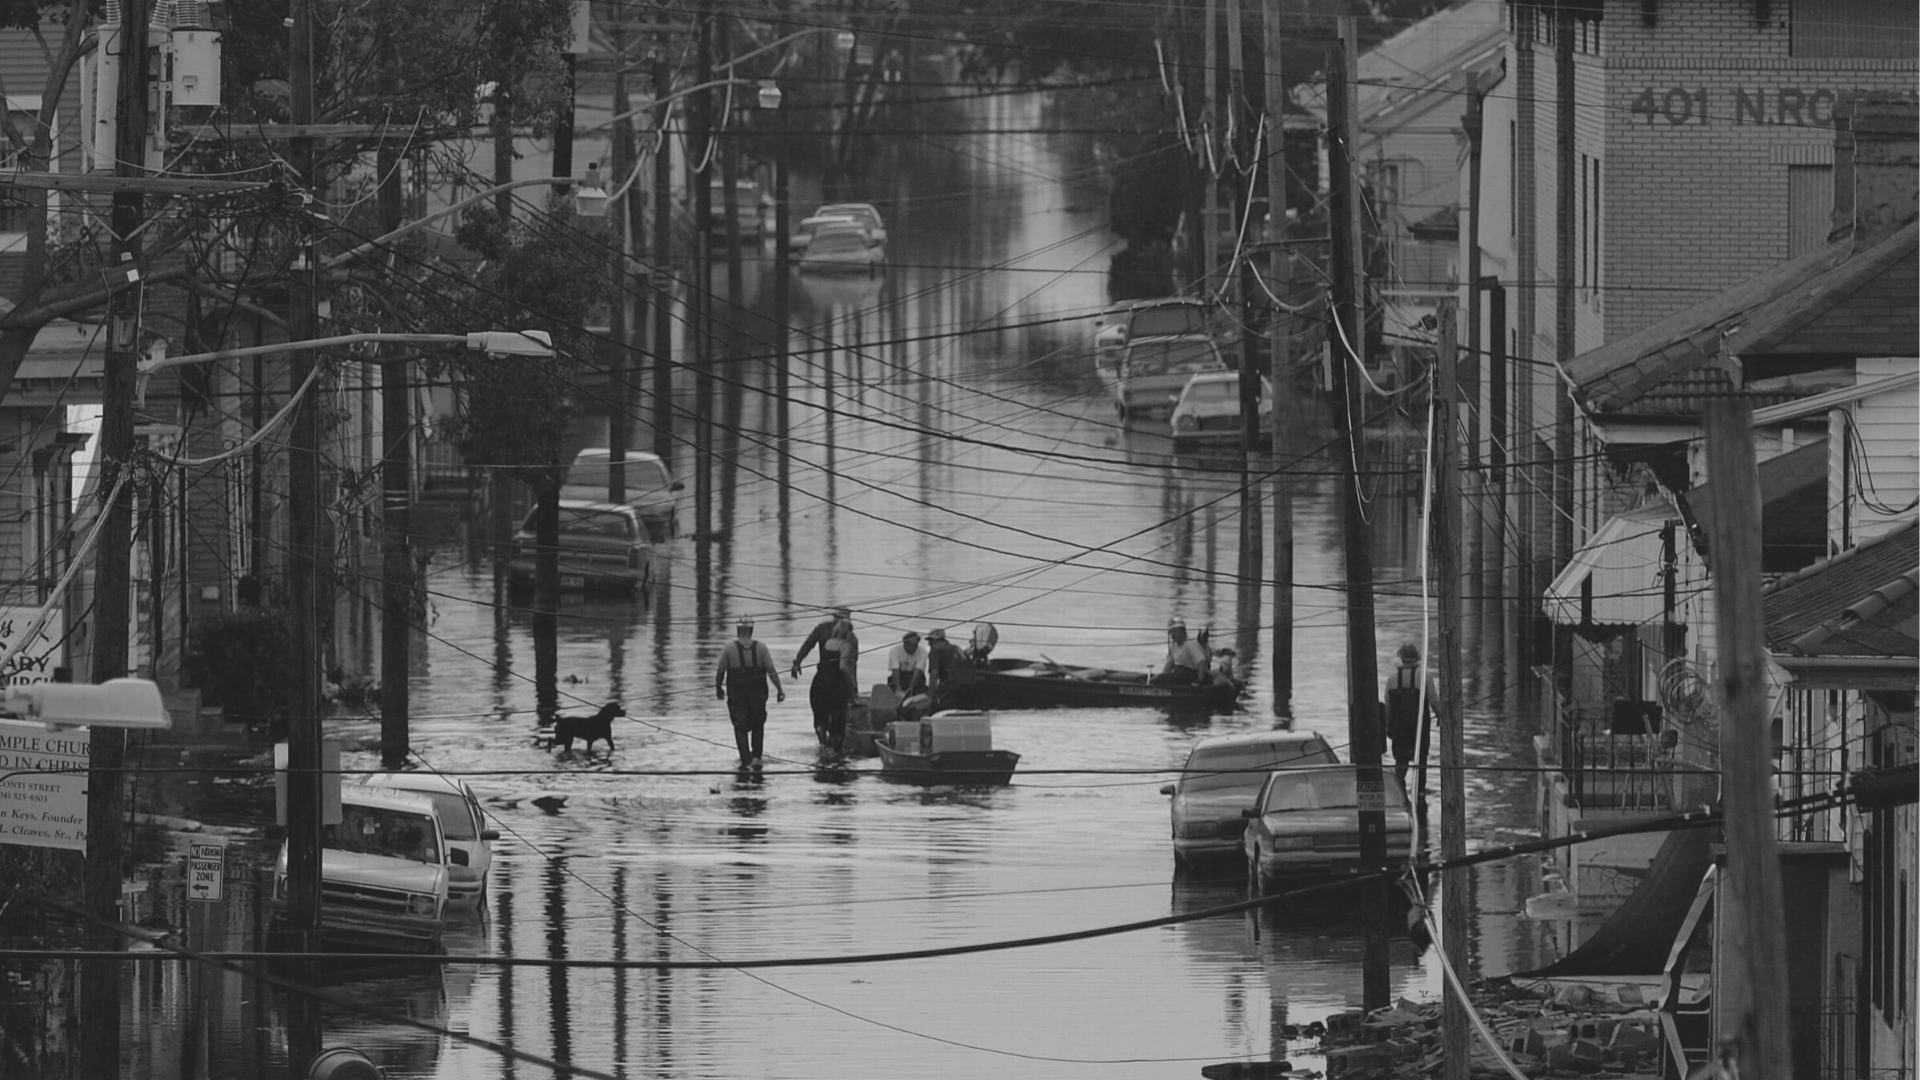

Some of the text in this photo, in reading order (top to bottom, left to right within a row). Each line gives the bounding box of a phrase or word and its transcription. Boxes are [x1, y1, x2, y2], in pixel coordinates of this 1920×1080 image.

[1632, 86, 1707, 126] 401
[0, 735, 40, 751] MPLE
[15, 756, 33, 769] IN
[38, 759, 90, 775] CHRIS
[0, 781, 62, 793] ONTI STREET
[12, 808, 37, 821] Keys,
[42, 812, 83, 825] Founder
[12, 825, 50, 838] Cleaves,
[191, 846, 221, 857] NO PARKING
[190, 861, 220, 871] PASSENGER
[196, 872, 214, 882] ZONE
